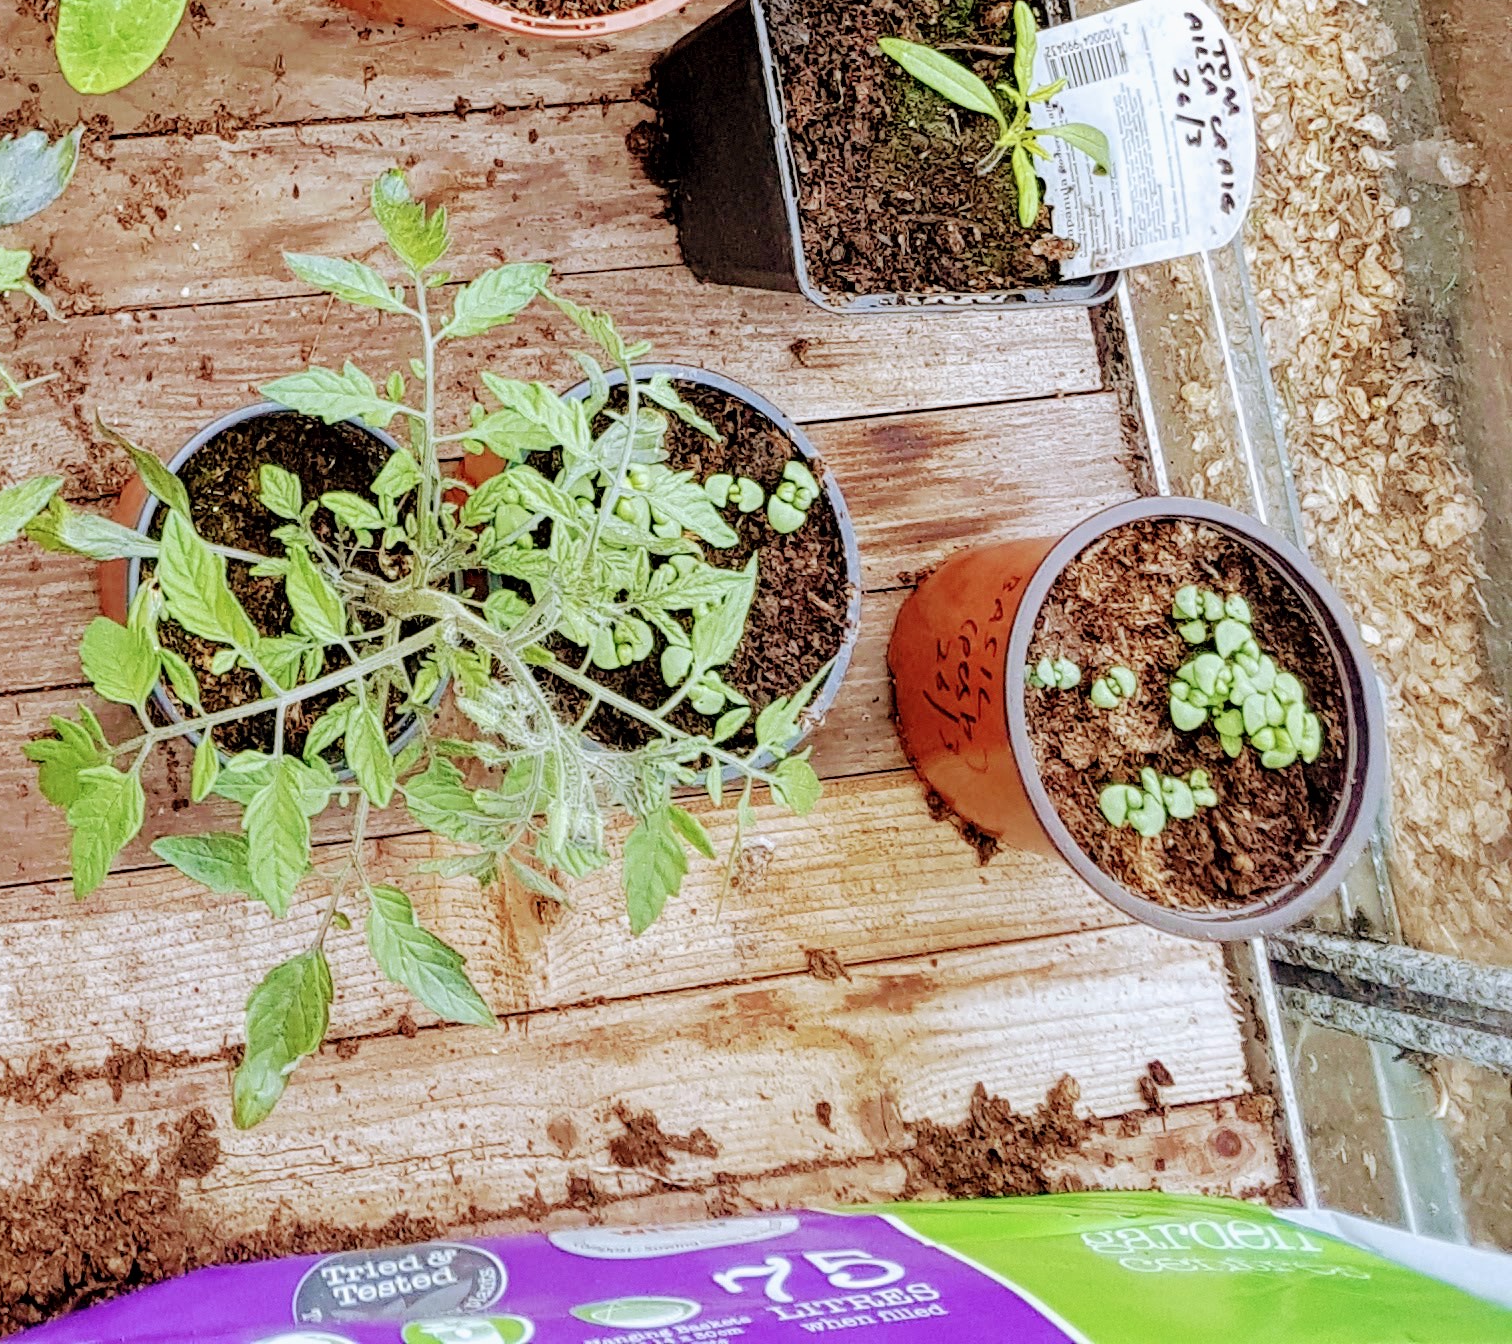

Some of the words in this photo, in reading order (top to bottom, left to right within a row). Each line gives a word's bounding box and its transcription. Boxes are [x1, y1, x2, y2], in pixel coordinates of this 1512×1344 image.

[1183, 11, 1219, 96] AILSA
[1212, 38, 1241, 116] TOM
[1173, 67, 1207, 148] 26/3
[321, 1251, 424, 1289] Tried
[333, 1266, 458, 1308] Tested
[712, 1247, 907, 1304] 75
[766, 1281, 942, 1324] LITRES
[799, 1312, 877, 1334] when
[874, 1304, 949, 1328] filled
[672, 1315, 754, 1335] Baskets
